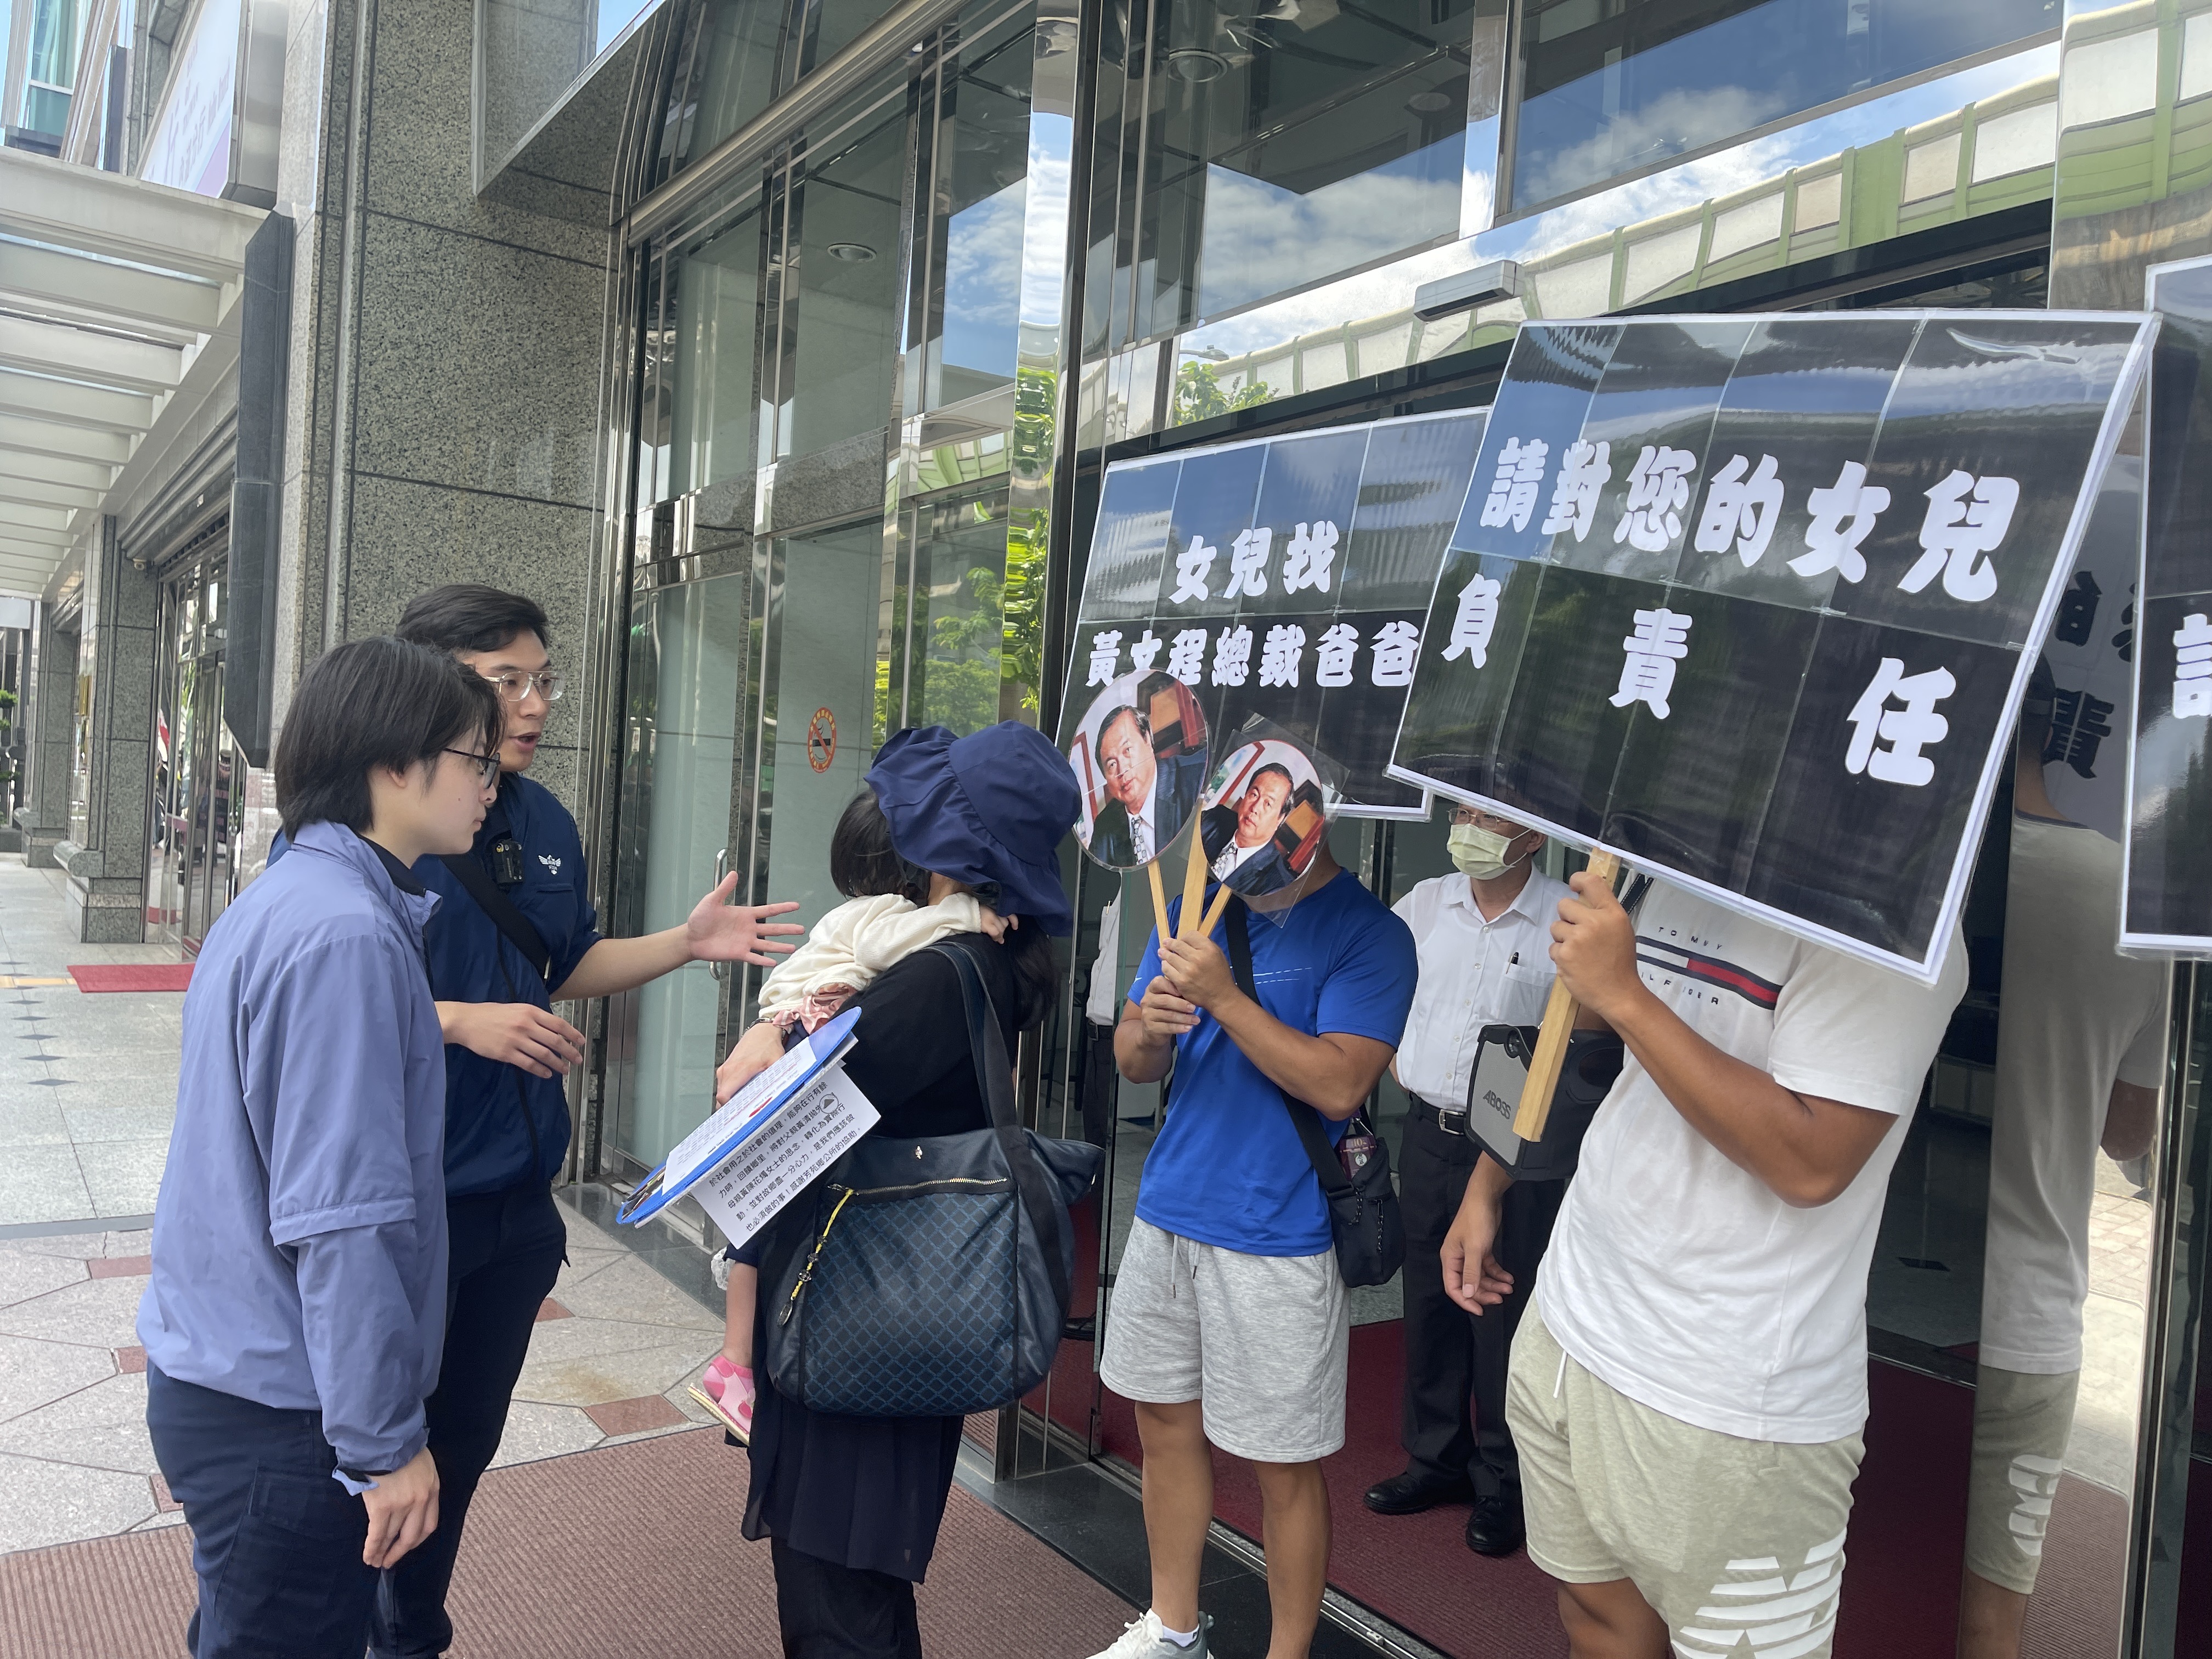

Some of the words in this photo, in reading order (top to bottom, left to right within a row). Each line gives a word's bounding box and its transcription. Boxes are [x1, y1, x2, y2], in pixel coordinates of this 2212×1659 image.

[1480, 437, 2019, 602] 請對您的女兒
[1169, 520, 1339, 604] 女兒找
[1084, 620, 1419, 688] 黃文程總裁爸爸
[1441, 572, 1956, 787] 負責任
[1658, 927, 1723, 950] TOMMY
[1641, 972, 1719, 1005] ILFIGER
[1482, 1090, 1511, 1120] ABOSS
